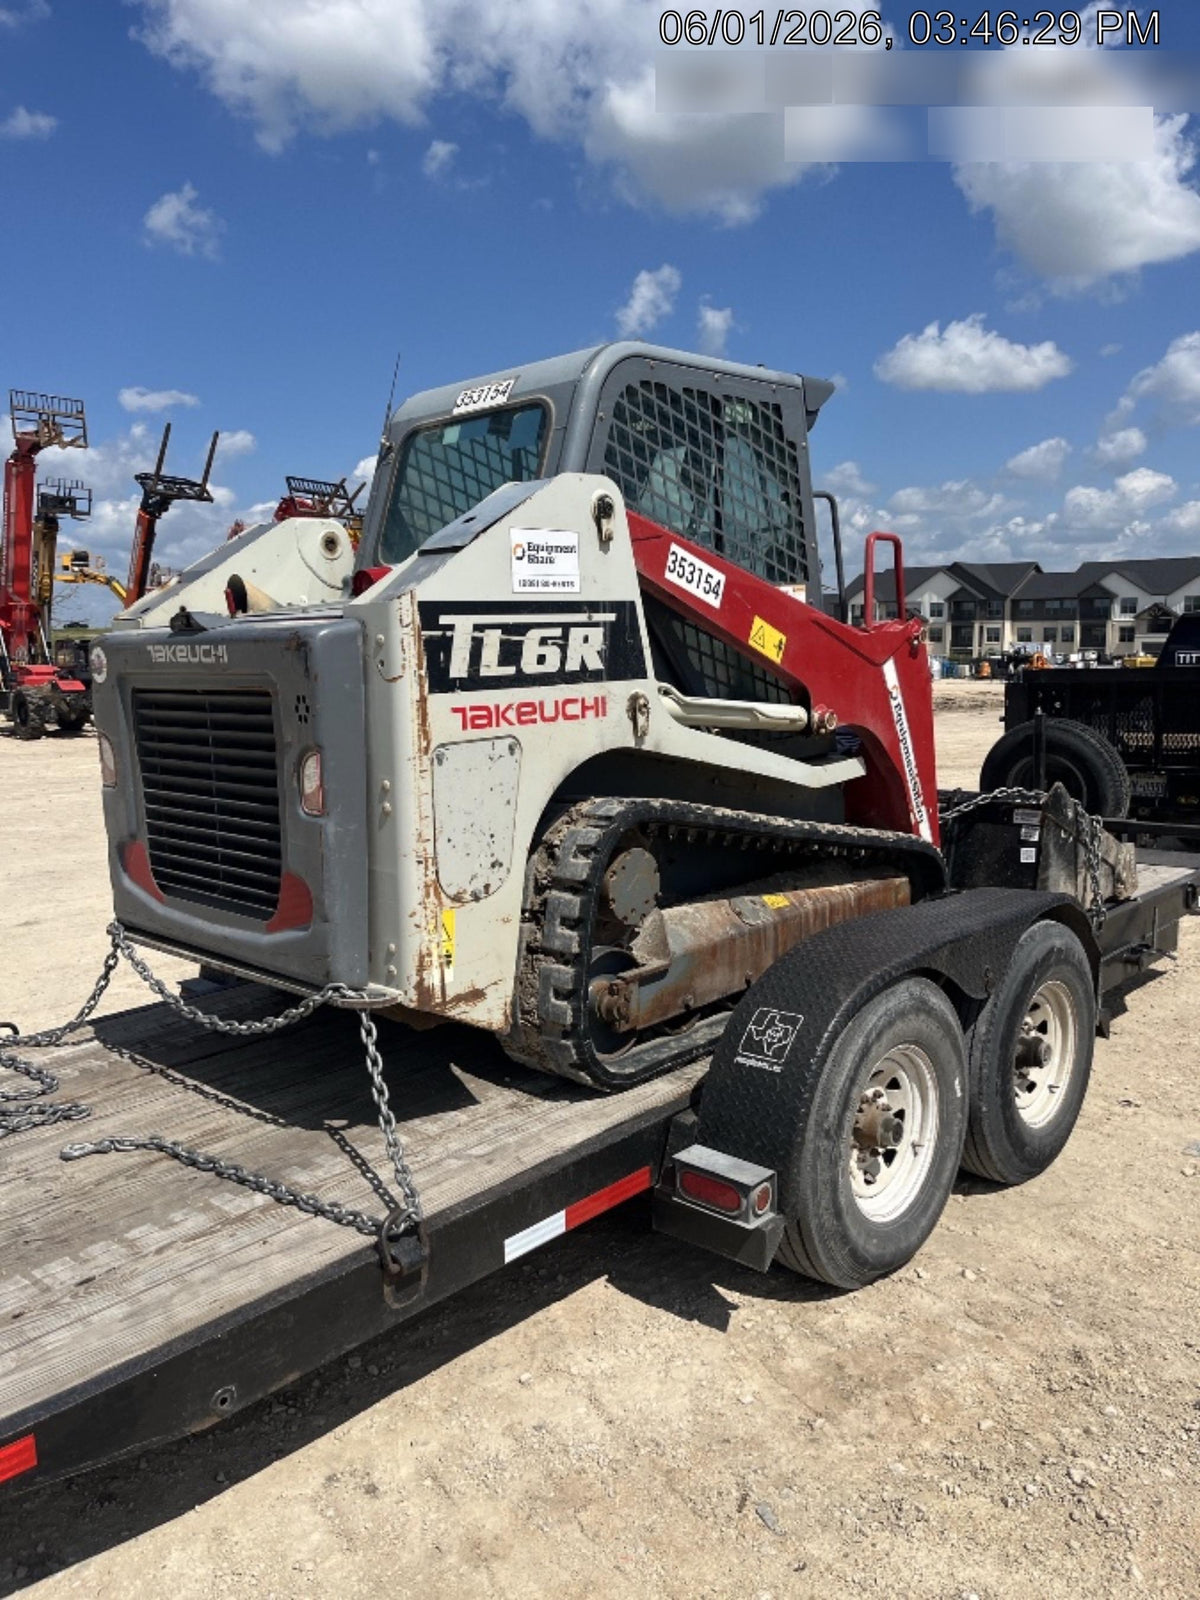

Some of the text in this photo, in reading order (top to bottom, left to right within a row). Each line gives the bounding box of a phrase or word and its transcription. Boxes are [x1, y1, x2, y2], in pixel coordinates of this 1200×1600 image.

[456, 382, 511, 408] 353154
[668, 550, 721, 600] 353154
[438, 612, 617, 679] TL6R
